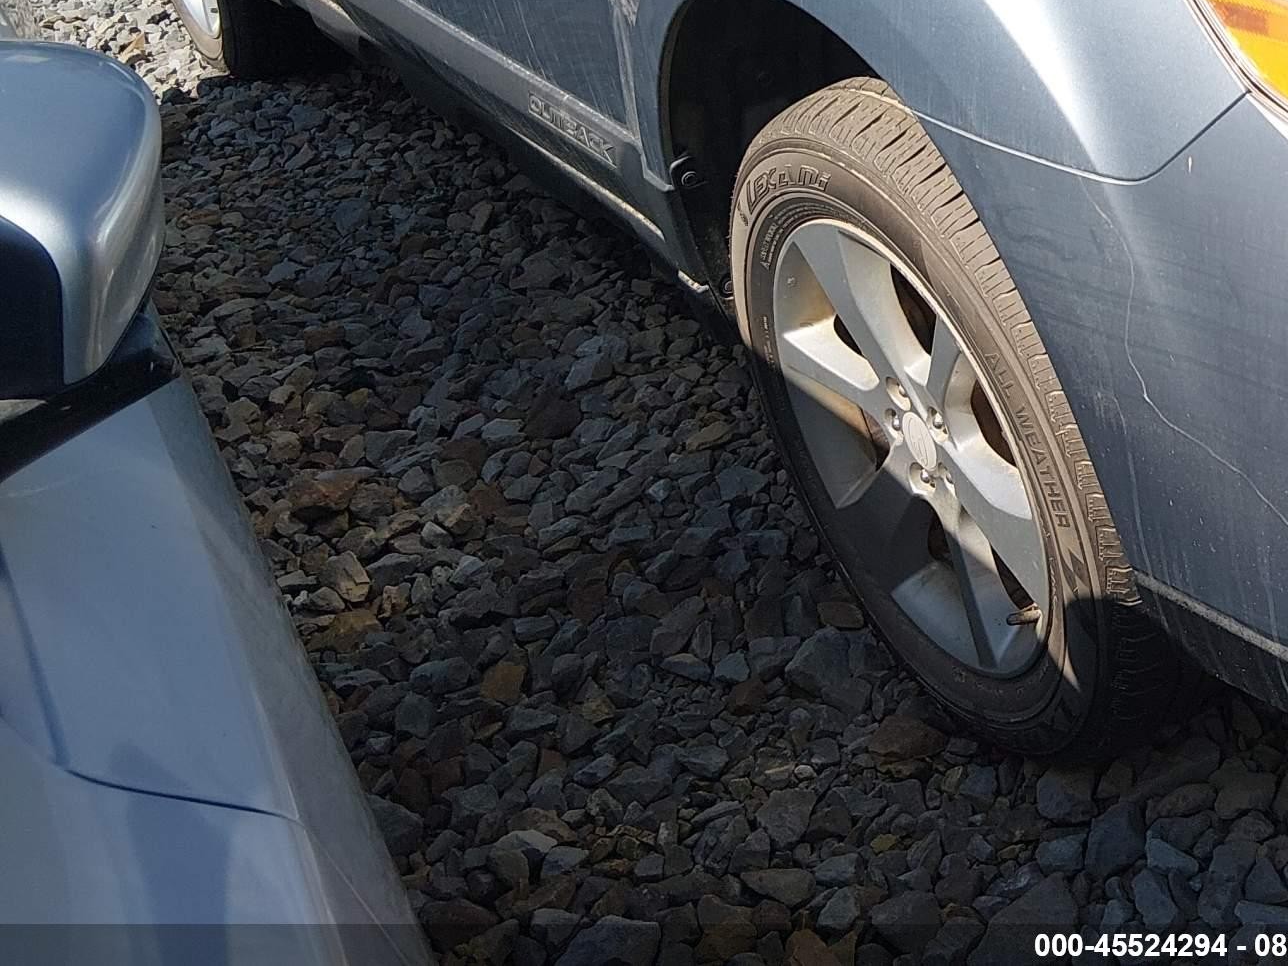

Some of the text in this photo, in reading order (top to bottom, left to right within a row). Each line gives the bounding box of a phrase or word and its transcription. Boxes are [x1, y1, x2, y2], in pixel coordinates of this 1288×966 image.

[529, 94, 615, 165] OUTBACK
[984, 353, 1071, 528] ALL WEATHER
